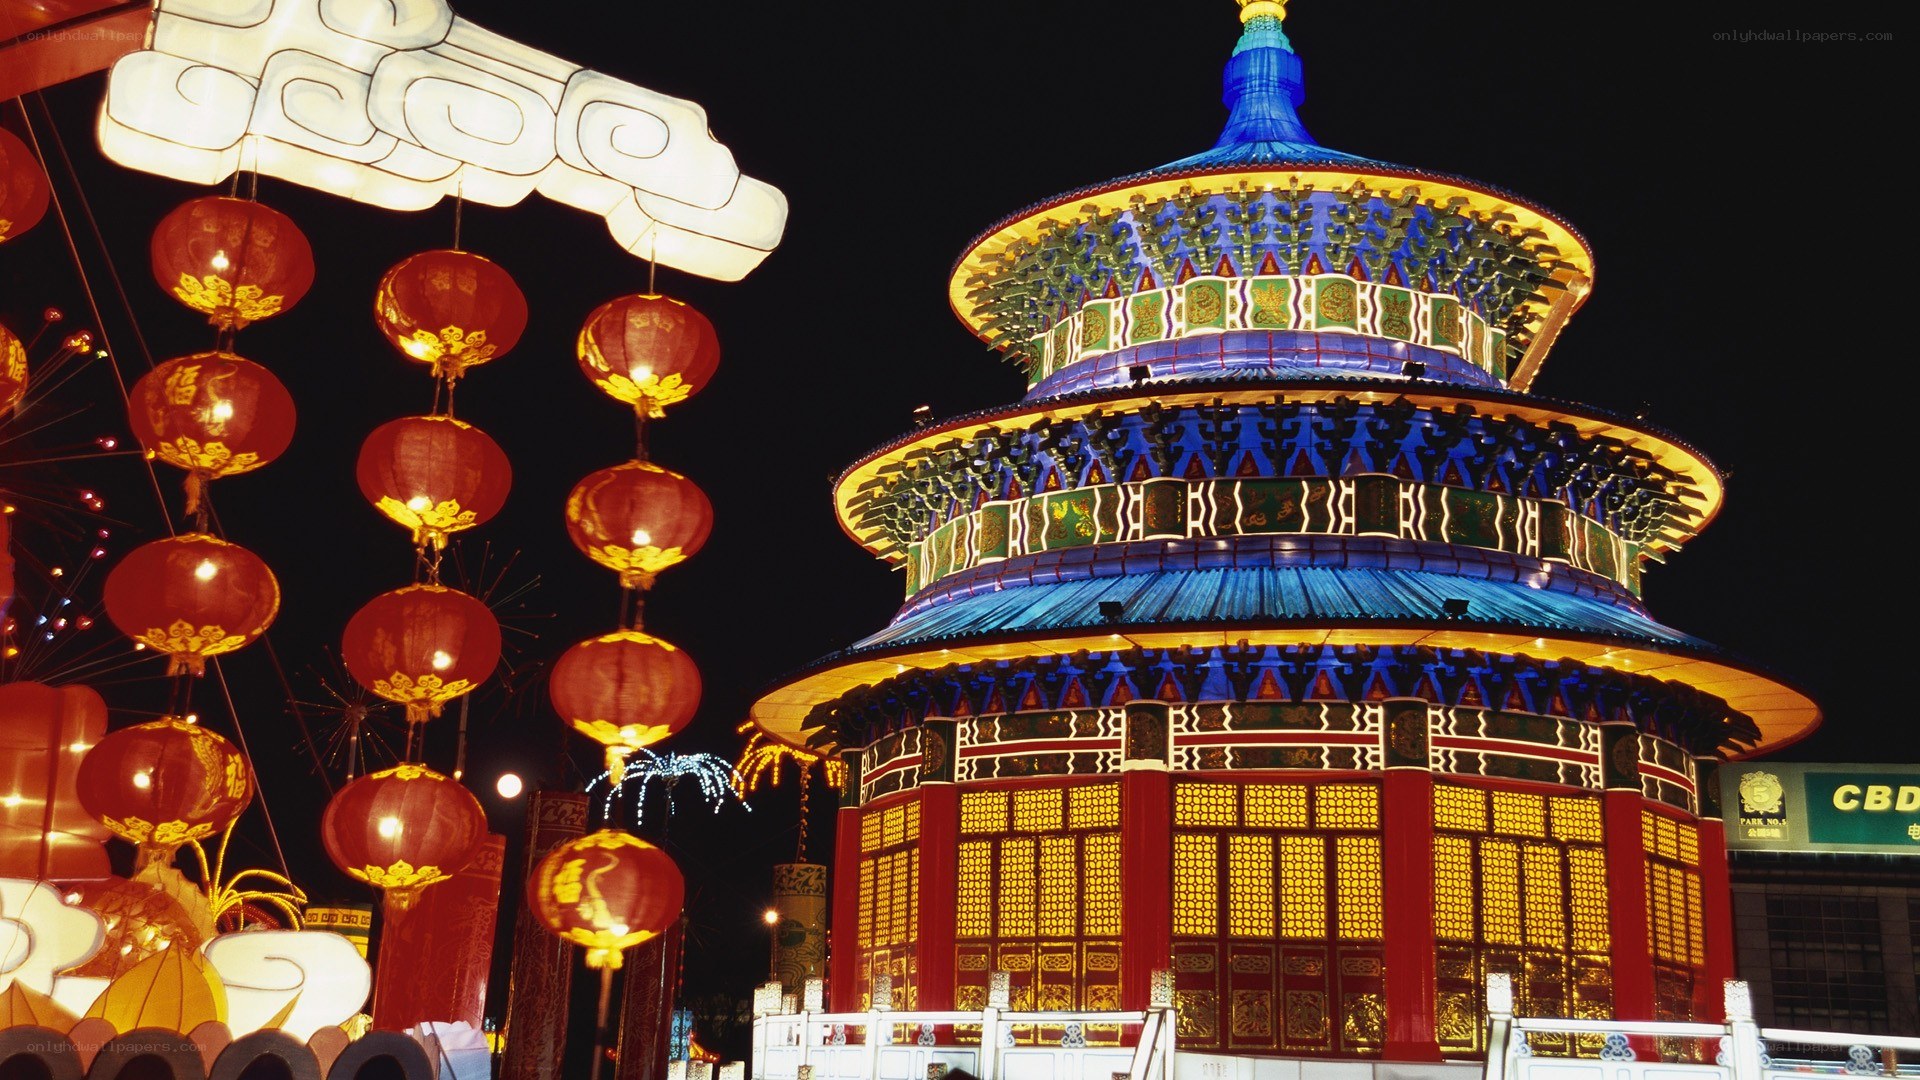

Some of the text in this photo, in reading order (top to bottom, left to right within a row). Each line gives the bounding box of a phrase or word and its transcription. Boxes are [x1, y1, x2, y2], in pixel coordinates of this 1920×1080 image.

[165, 365, 202, 405] 福
[226, 752, 246, 799] 福
[1753, 786, 1770, 803] 5
[1833, 784, 1920, 811] CBD
[1740, 818, 1763, 826] PARK
